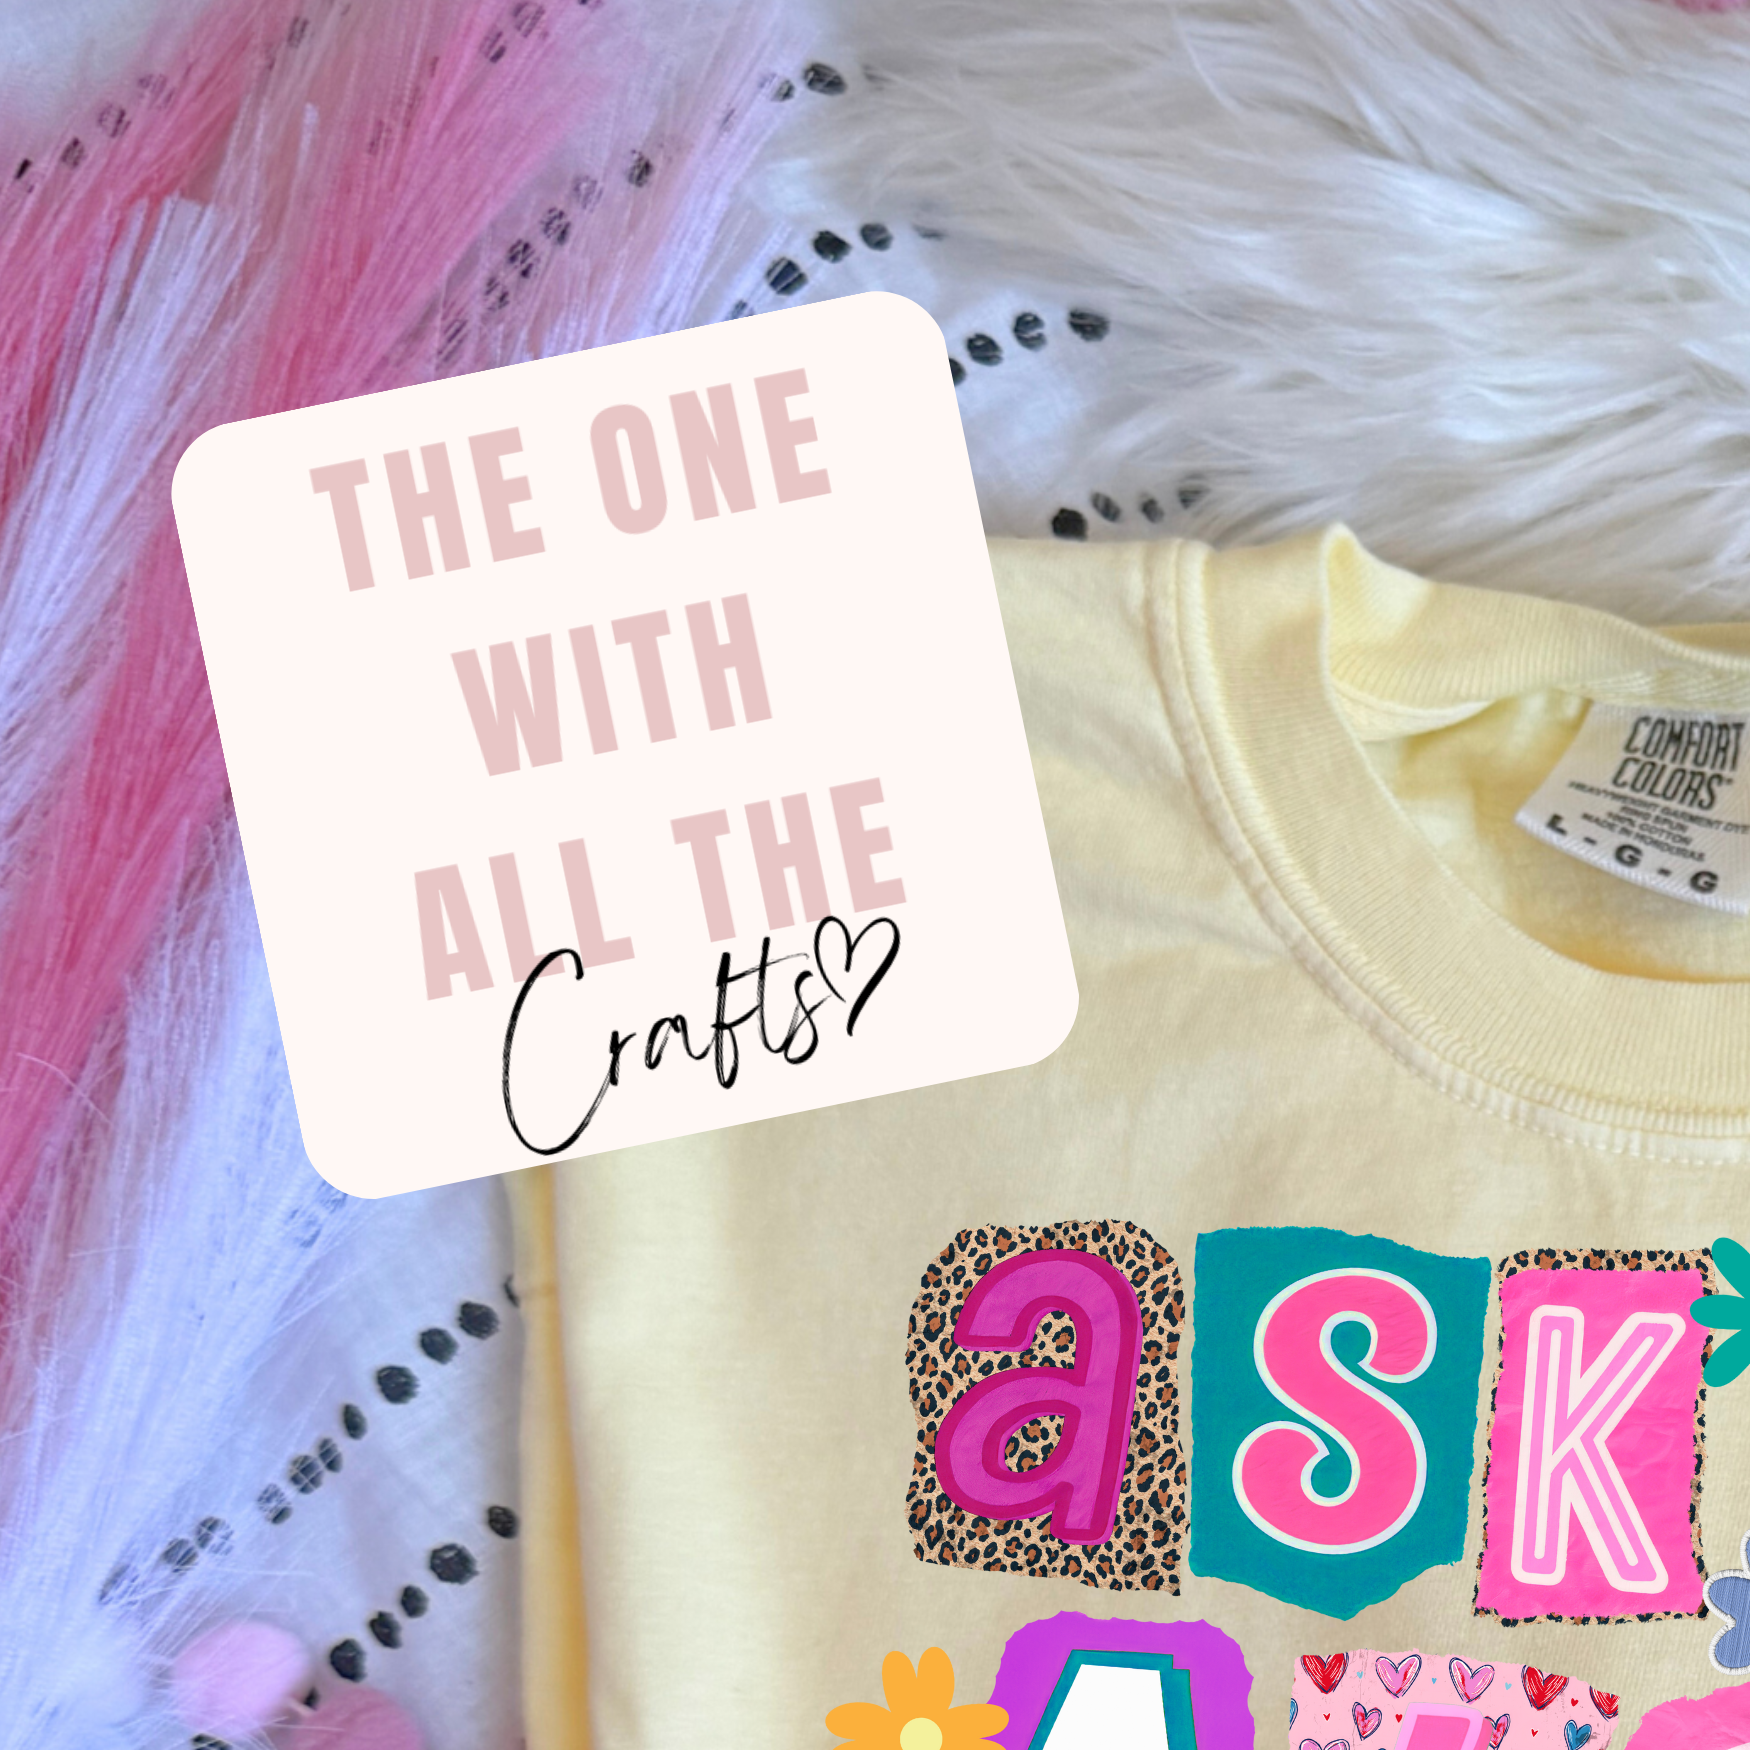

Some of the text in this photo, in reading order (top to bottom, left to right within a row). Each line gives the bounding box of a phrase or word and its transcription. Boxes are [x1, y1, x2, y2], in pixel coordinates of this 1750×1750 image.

[1624, 716, 1745, 771] COMFORT
[1546, 814, 1567, 836] L
[1614, 844, 1643, 868] G
[1689, 871, 1719, 894] G
[1638, 823, 1693, 846] COTTON
